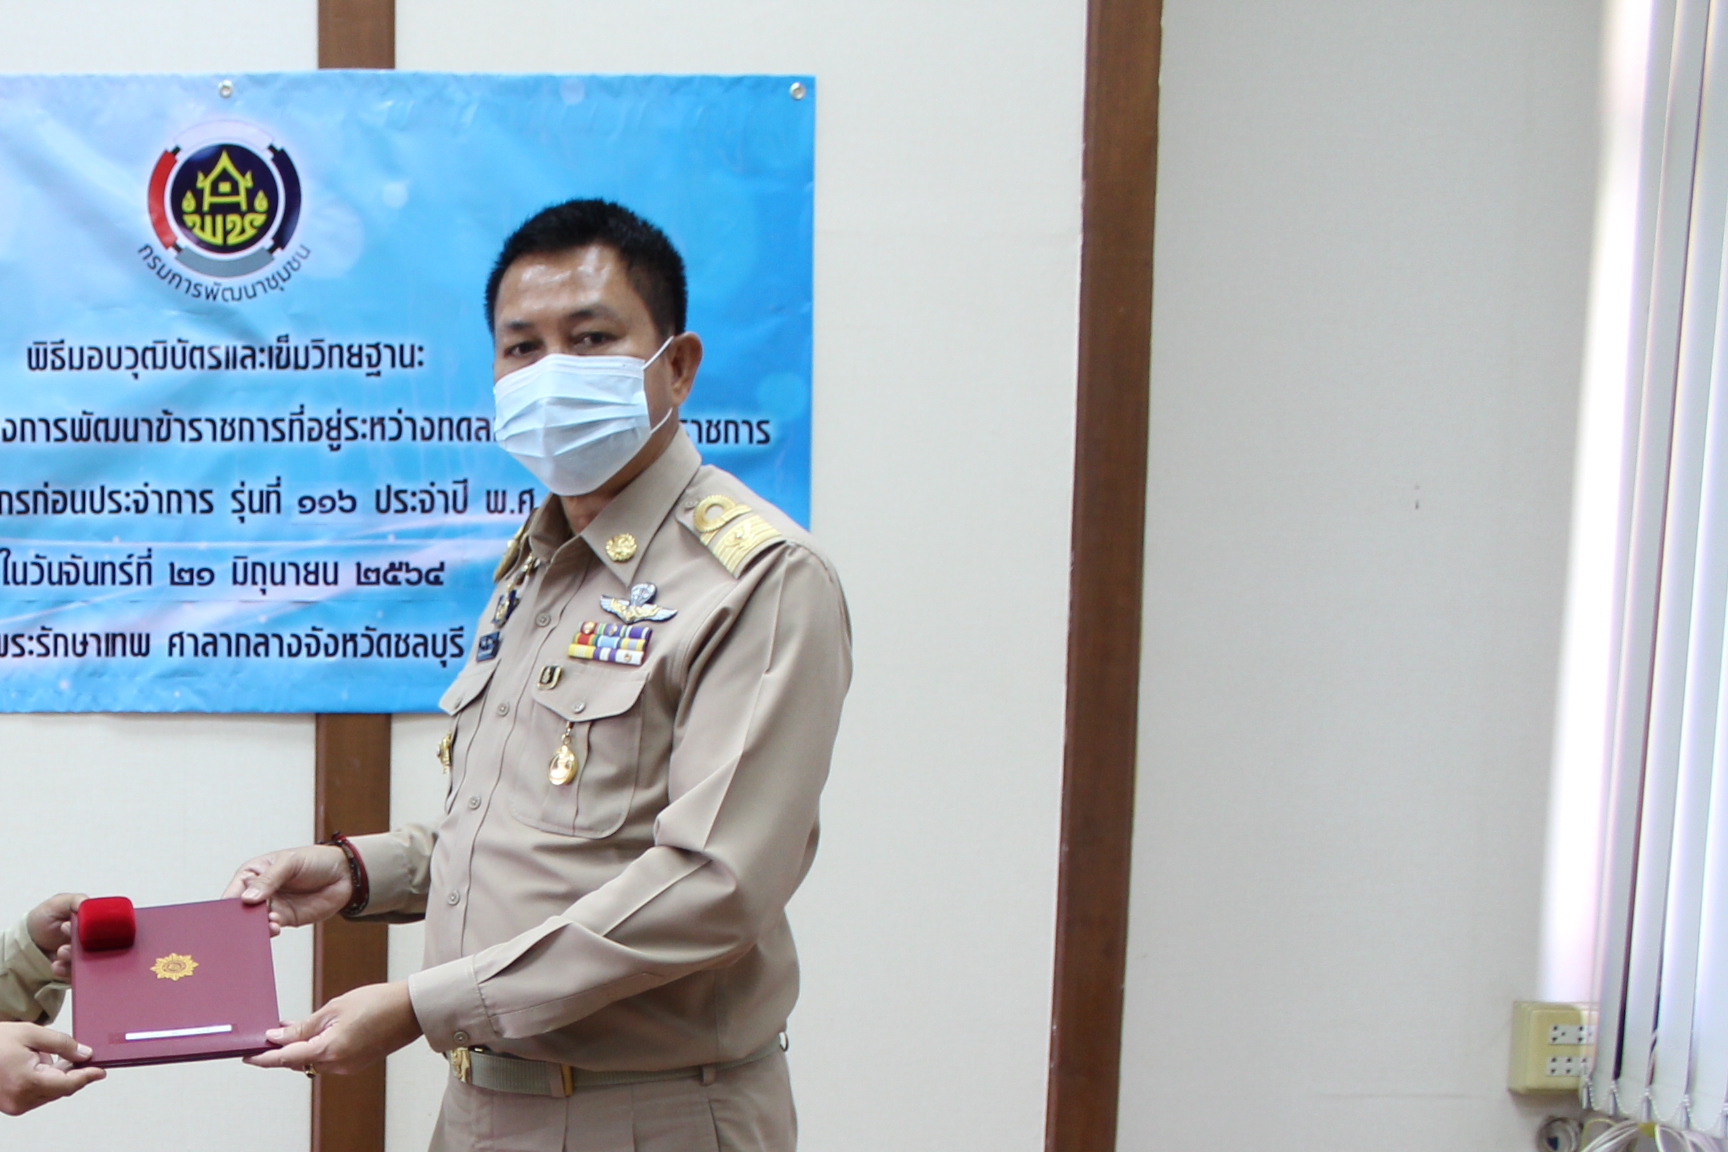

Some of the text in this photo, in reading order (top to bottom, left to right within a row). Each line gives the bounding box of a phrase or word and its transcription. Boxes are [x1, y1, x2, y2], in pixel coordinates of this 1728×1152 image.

[137, 243, 311, 302] กรมการพัฒนาชุมชน
[26, 334, 425, 380] พิธีมอบวุฒิบัตรและเข็มวิทยฐานะ
[230, 476, 282, 524] รุ่นที่
[297, 489, 357, 514] ๑๑๖
[375, 478, 469, 515] ประจำปี
[169, 561, 215, 587] ๒๑
[231, 555, 339, 596] มิถุนายน
[355, 560, 445, 587] ๒๕๖๔
[167, 624, 465, 668] ศาลากลางจังหวัดชลบุรี
